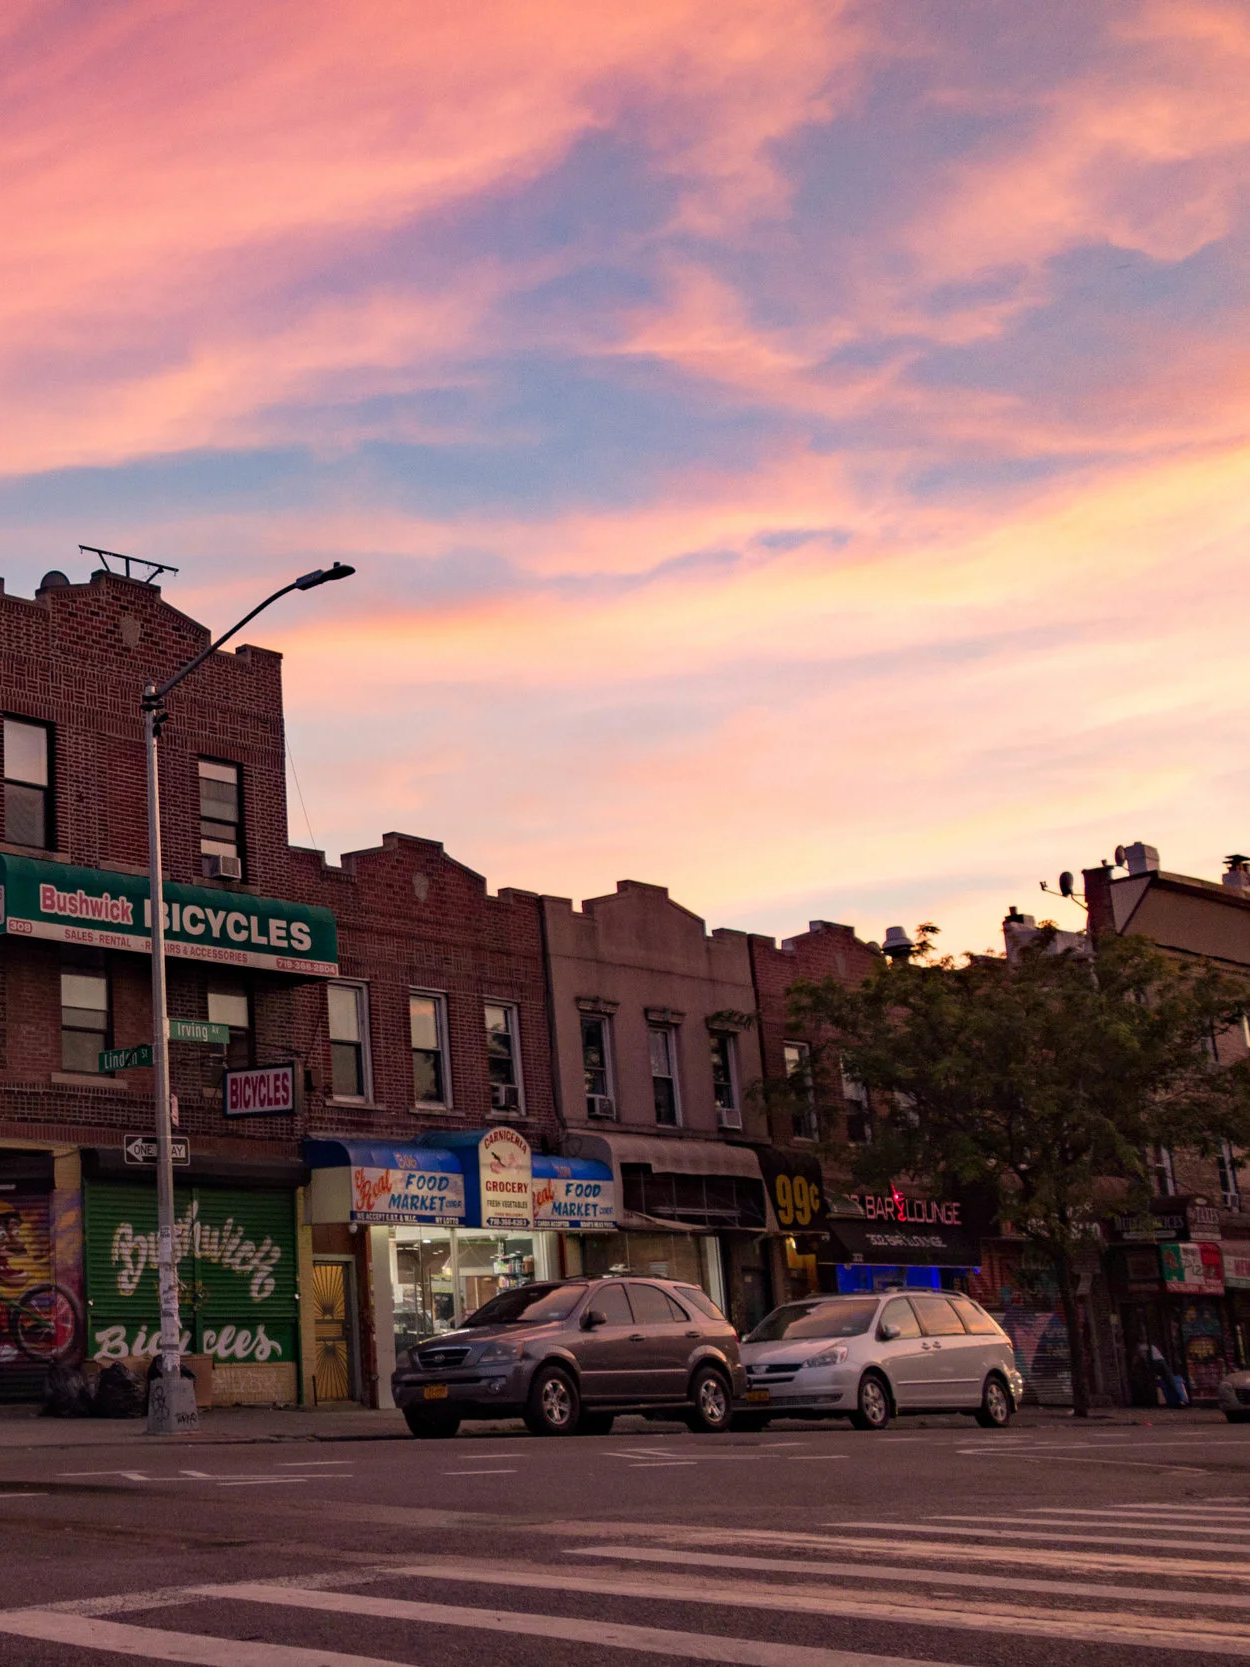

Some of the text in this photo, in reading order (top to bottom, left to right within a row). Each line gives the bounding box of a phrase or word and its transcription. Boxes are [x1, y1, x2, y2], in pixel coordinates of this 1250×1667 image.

[40, 884, 312, 951] Bushwick BICYCLES
[64, 929, 93, 943] SALES
[99, 935, 131, 948] RENTAL
[145, 941, 181, 954] RIRS
[190, 946, 248, 963] ACCESSORIES
[177, 1022, 208, 1042] Irving
[230, 1072, 290, 1109] BICYCLES
[134, 1144, 183, 1155] ONE AY
[484, 1130, 527, 1154] CARNICERIA
[355, 1168, 392, 1211] Real
[406, 1173, 449, 1191] FOOD
[486, 1181, 529, 1193] GROCERY
[565, 1183, 601, 1198] FOOD
[389, 1194, 446, 1211] MARKET
[551, 1201, 598, 1217] MARKET
[865, 1195, 962, 1225] BAR LOUNGE
[366, 1213, 385, 1221] ACCEPT
